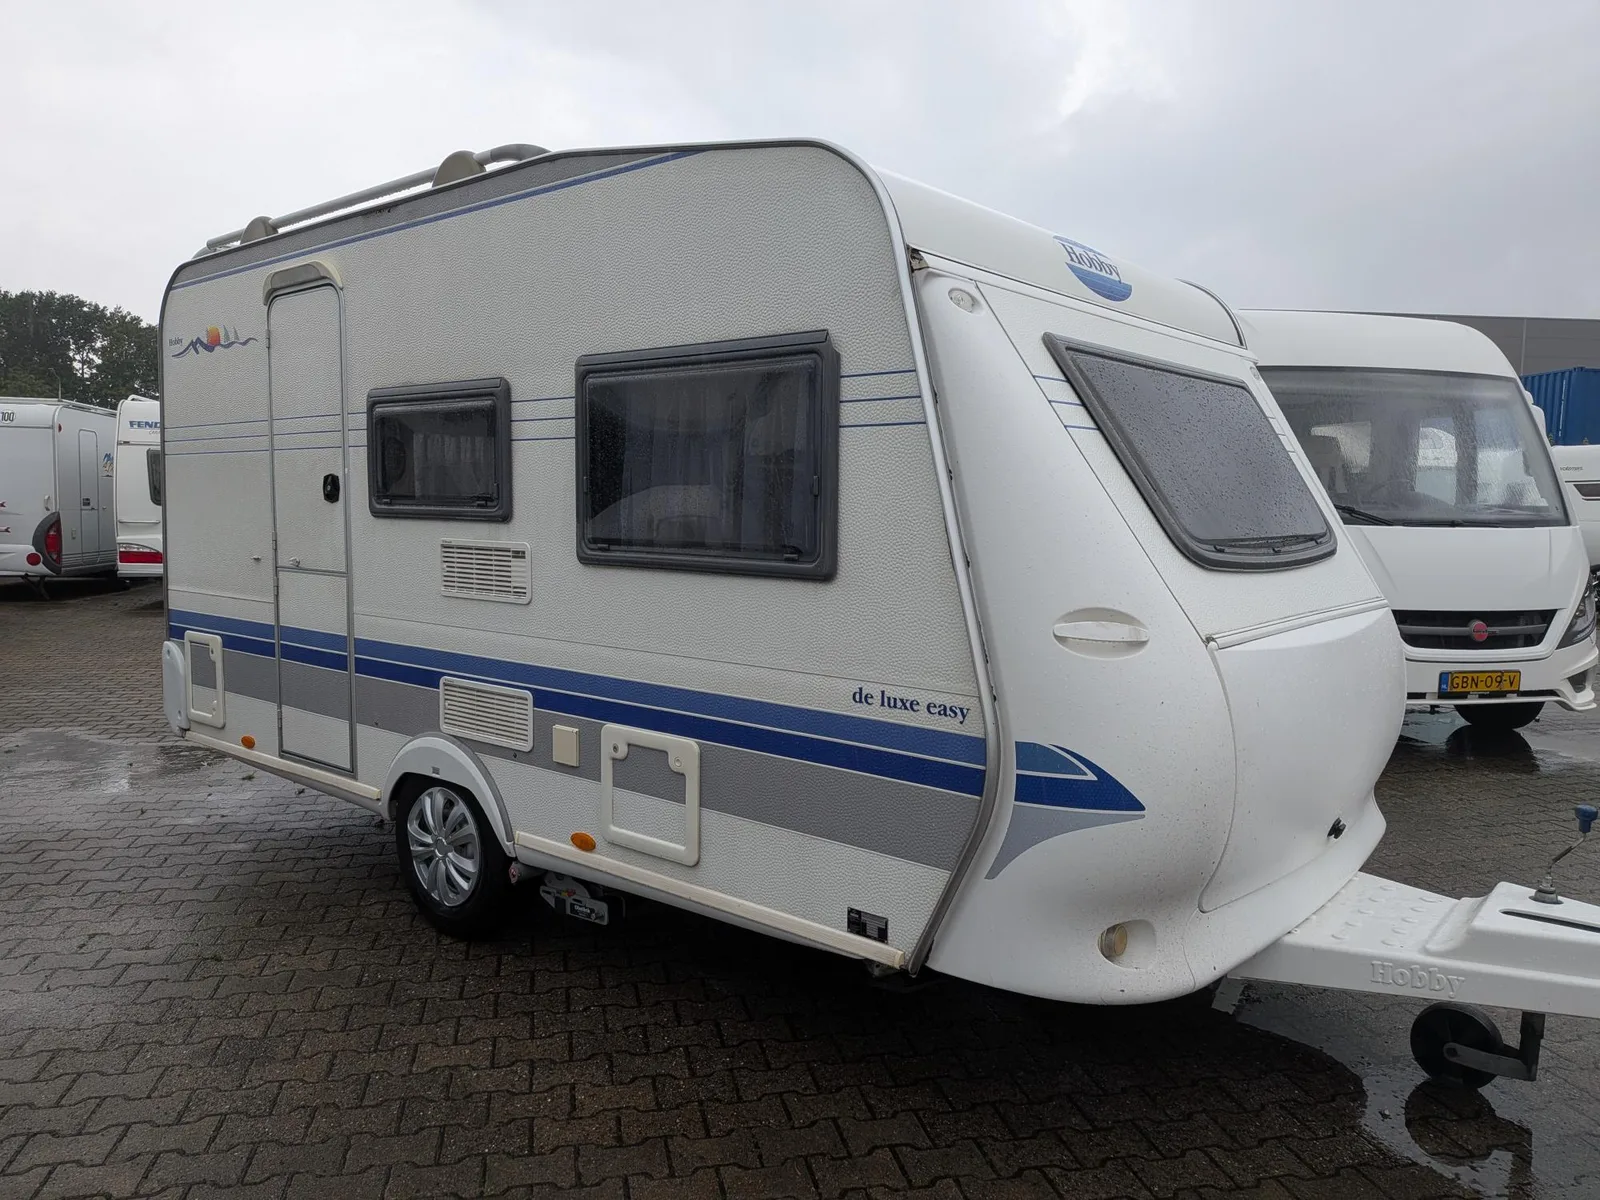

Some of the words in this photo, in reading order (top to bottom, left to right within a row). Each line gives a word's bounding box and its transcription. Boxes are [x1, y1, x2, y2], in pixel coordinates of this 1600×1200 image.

[1060, 242, 1122, 283] Hobby
[1, 411, 15, 422] 100
[1452, 675, 1516, 689] GBN-09-V
[852, 687, 874, 705] de
[880, 690, 920, 712] luxe
[926, 702, 971, 724] easy
[1370, 960, 1466, 998] Hobby
